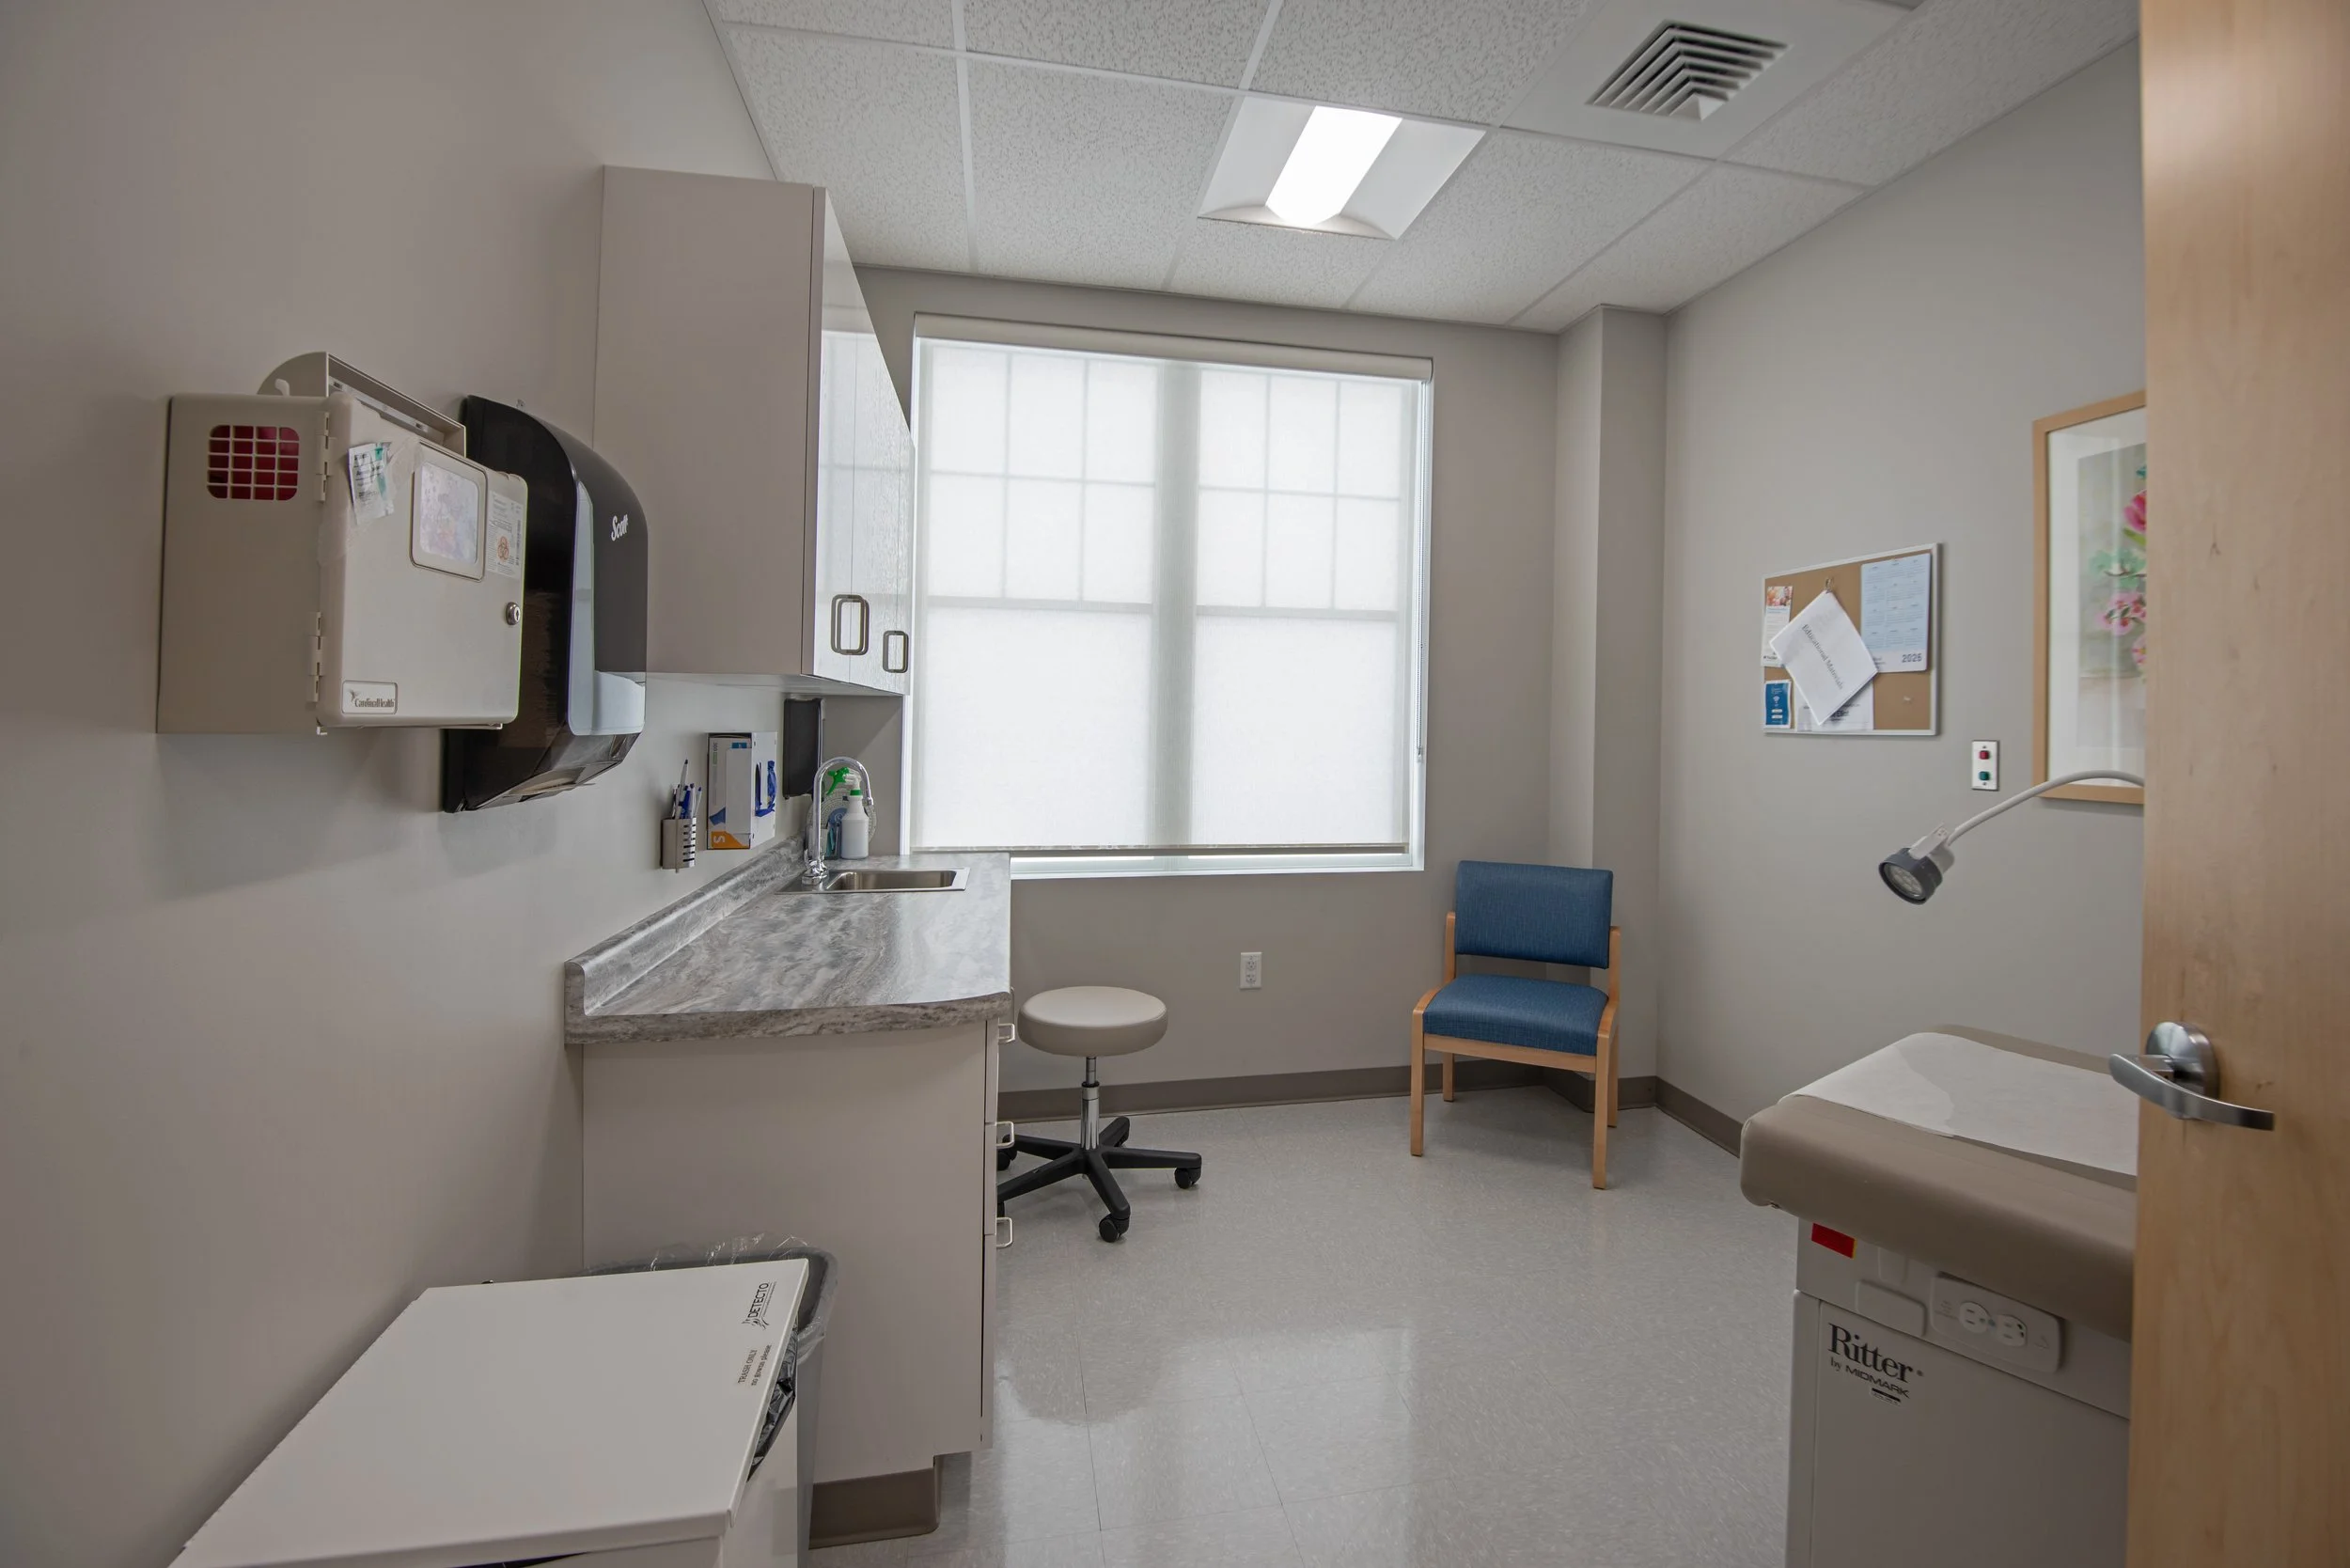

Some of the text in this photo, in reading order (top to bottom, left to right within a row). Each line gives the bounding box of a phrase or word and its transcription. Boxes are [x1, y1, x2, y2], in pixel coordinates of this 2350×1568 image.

[611, 514, 628, 541] Scott
[1801, 623, 1828, 662] Educational
[747, 1282, 769, 1318] DETECTO
[738, 1349, 758, 1384] TRASH ONLY
[1827, 1322, 1914, 1384] Ritter
[1830, 1356, 1841, 1372] by
[1845, 1365, 1911, 1400] MIDMARK
